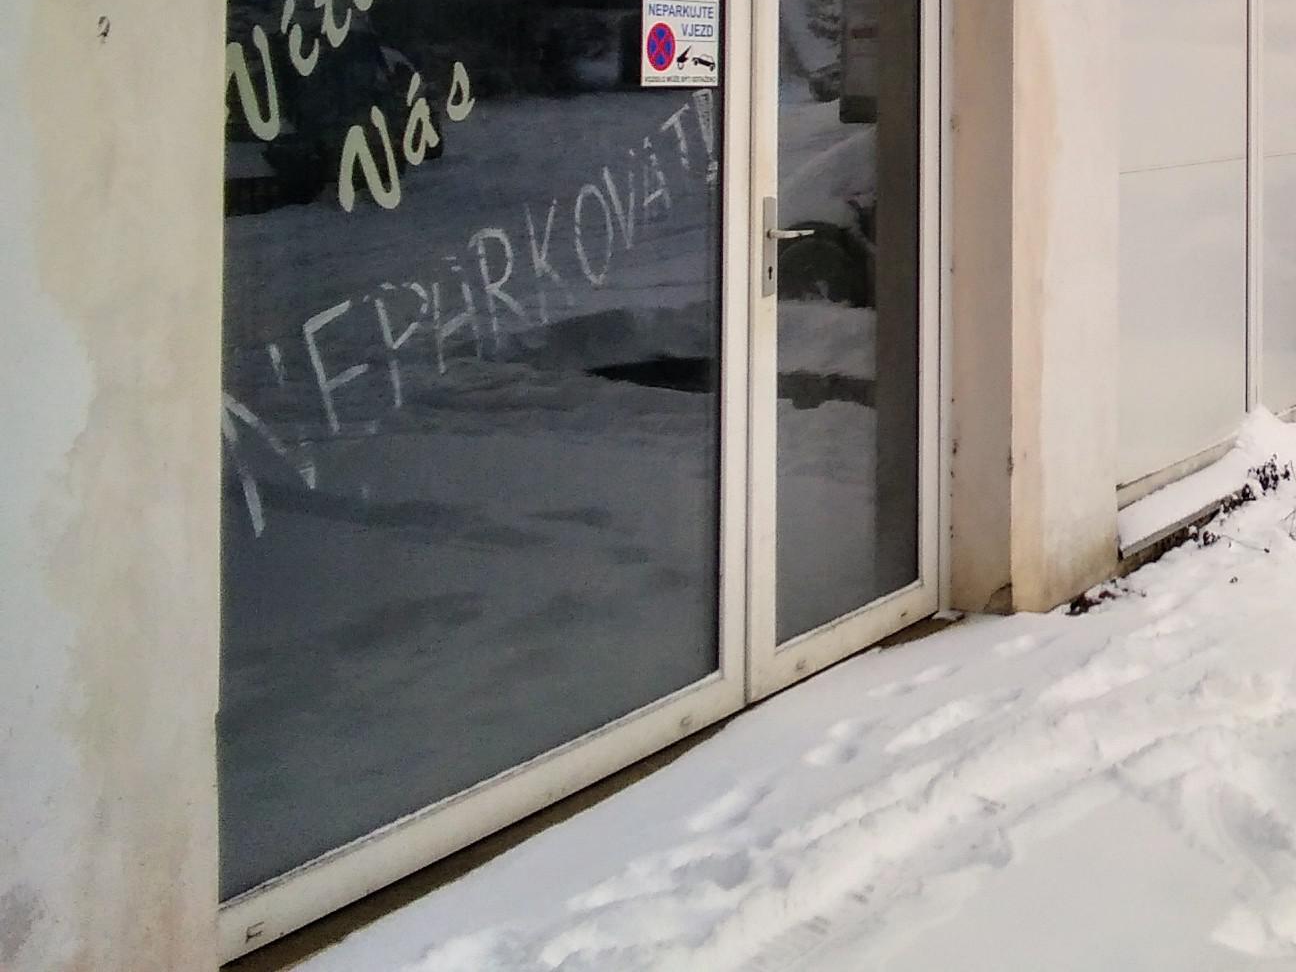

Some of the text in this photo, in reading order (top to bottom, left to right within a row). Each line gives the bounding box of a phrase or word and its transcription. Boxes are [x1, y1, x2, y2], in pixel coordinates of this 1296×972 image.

[648, 3, 714, 19] NEPARKUJTE
[681, 23, 714, 38] VJEZD
[339, 62, 475, 212] Nás
